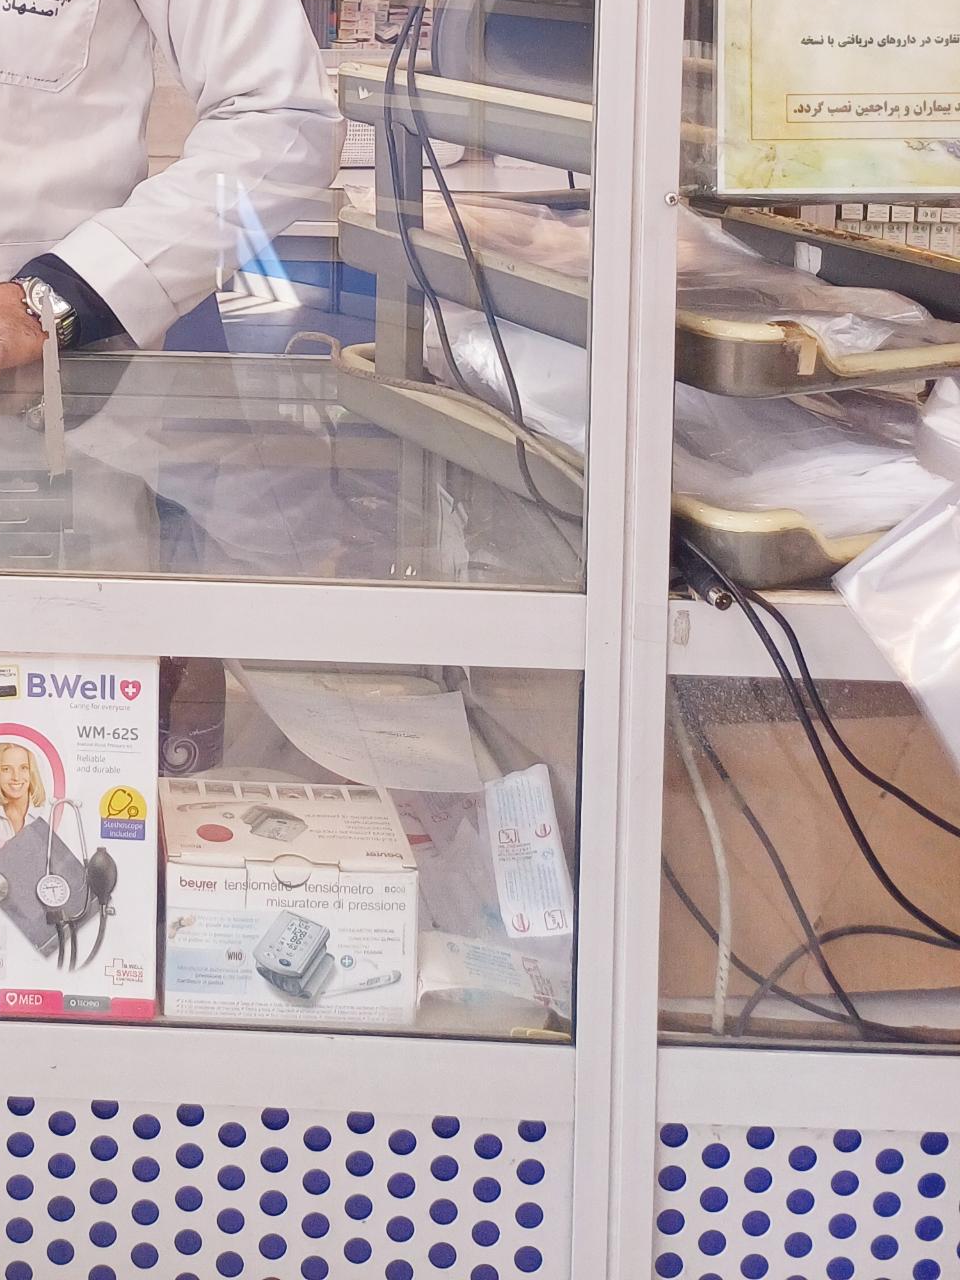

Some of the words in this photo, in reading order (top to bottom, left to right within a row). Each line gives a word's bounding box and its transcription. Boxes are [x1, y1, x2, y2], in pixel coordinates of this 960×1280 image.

[26, 672, 117, 702] B.Well
[101, 704, 132, 712] everyone
[76, 725, 140, 742] WM-62S
[76, 753, 107, 764] Reliable
[76, 765, 91, 774] and
[91, 764, 122, 775] durable
[103, 820, 144, 831] Stethoscope
[109, 830, 138, 839] included
[179, 876, 218, 892] beurer
[266, 897, 330, 911] misuratore
[332, 898, 345, 912] di
[347, 899, 407, 914] pressione
[227, 951, 244, 962] WHO
[18, 993, 43, 1006] MED
